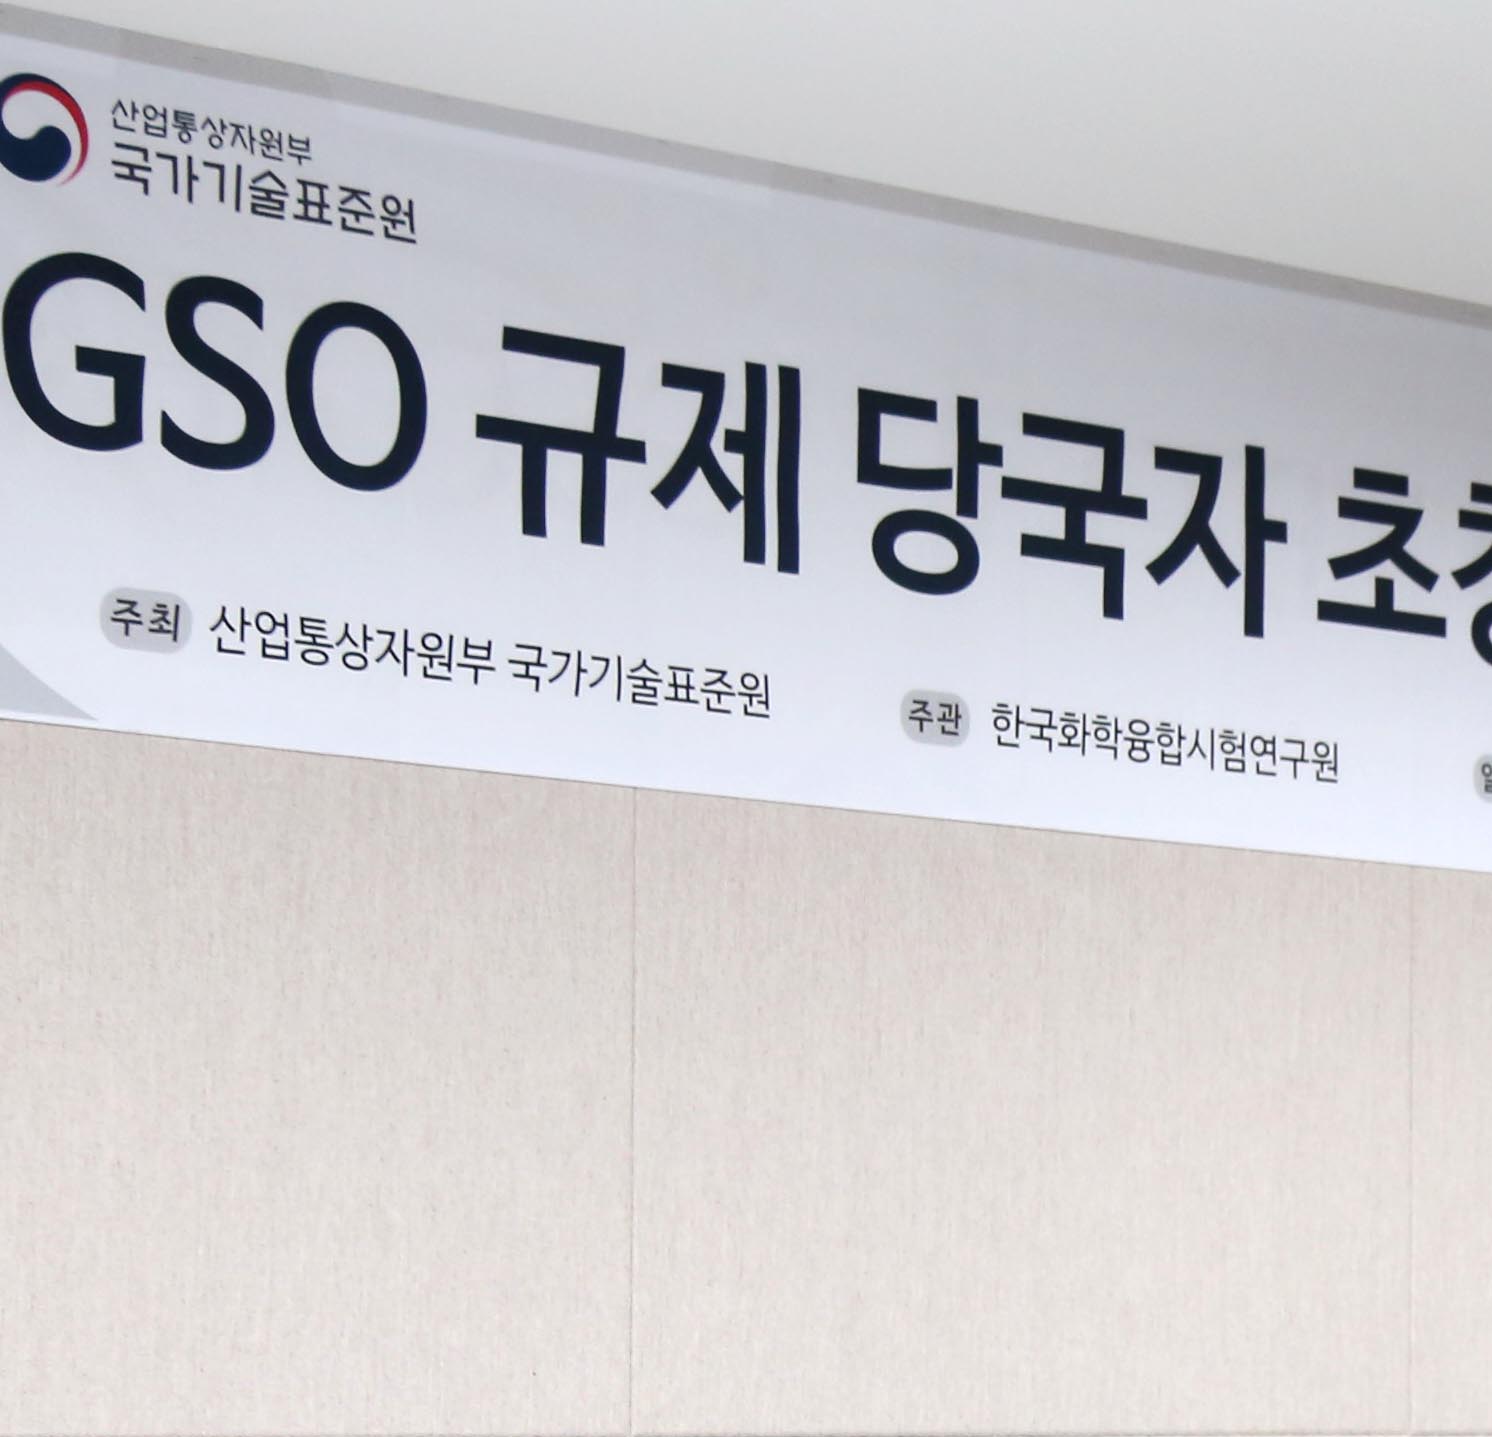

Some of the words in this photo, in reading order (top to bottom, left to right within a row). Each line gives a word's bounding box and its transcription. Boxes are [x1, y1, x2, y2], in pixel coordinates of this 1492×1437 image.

[110, 98, 313, 167] 산업통상자원부
[110, 143, 418, 244] 국가기술표준원
[1, 251, 428, 493] GSO
[475, 325, 802, 576] 규제
[856, 386, 1288, 640] 당국자
[110, 597, 181, 644] 주최
[209, 605, 497, 686] 산업통상자원부
[507, 642, 772, 720] 국가기술표준원
[908, 698, 963, 737] 주관
[991, 702, 1340, 784] 한국화학융합시험연구원
